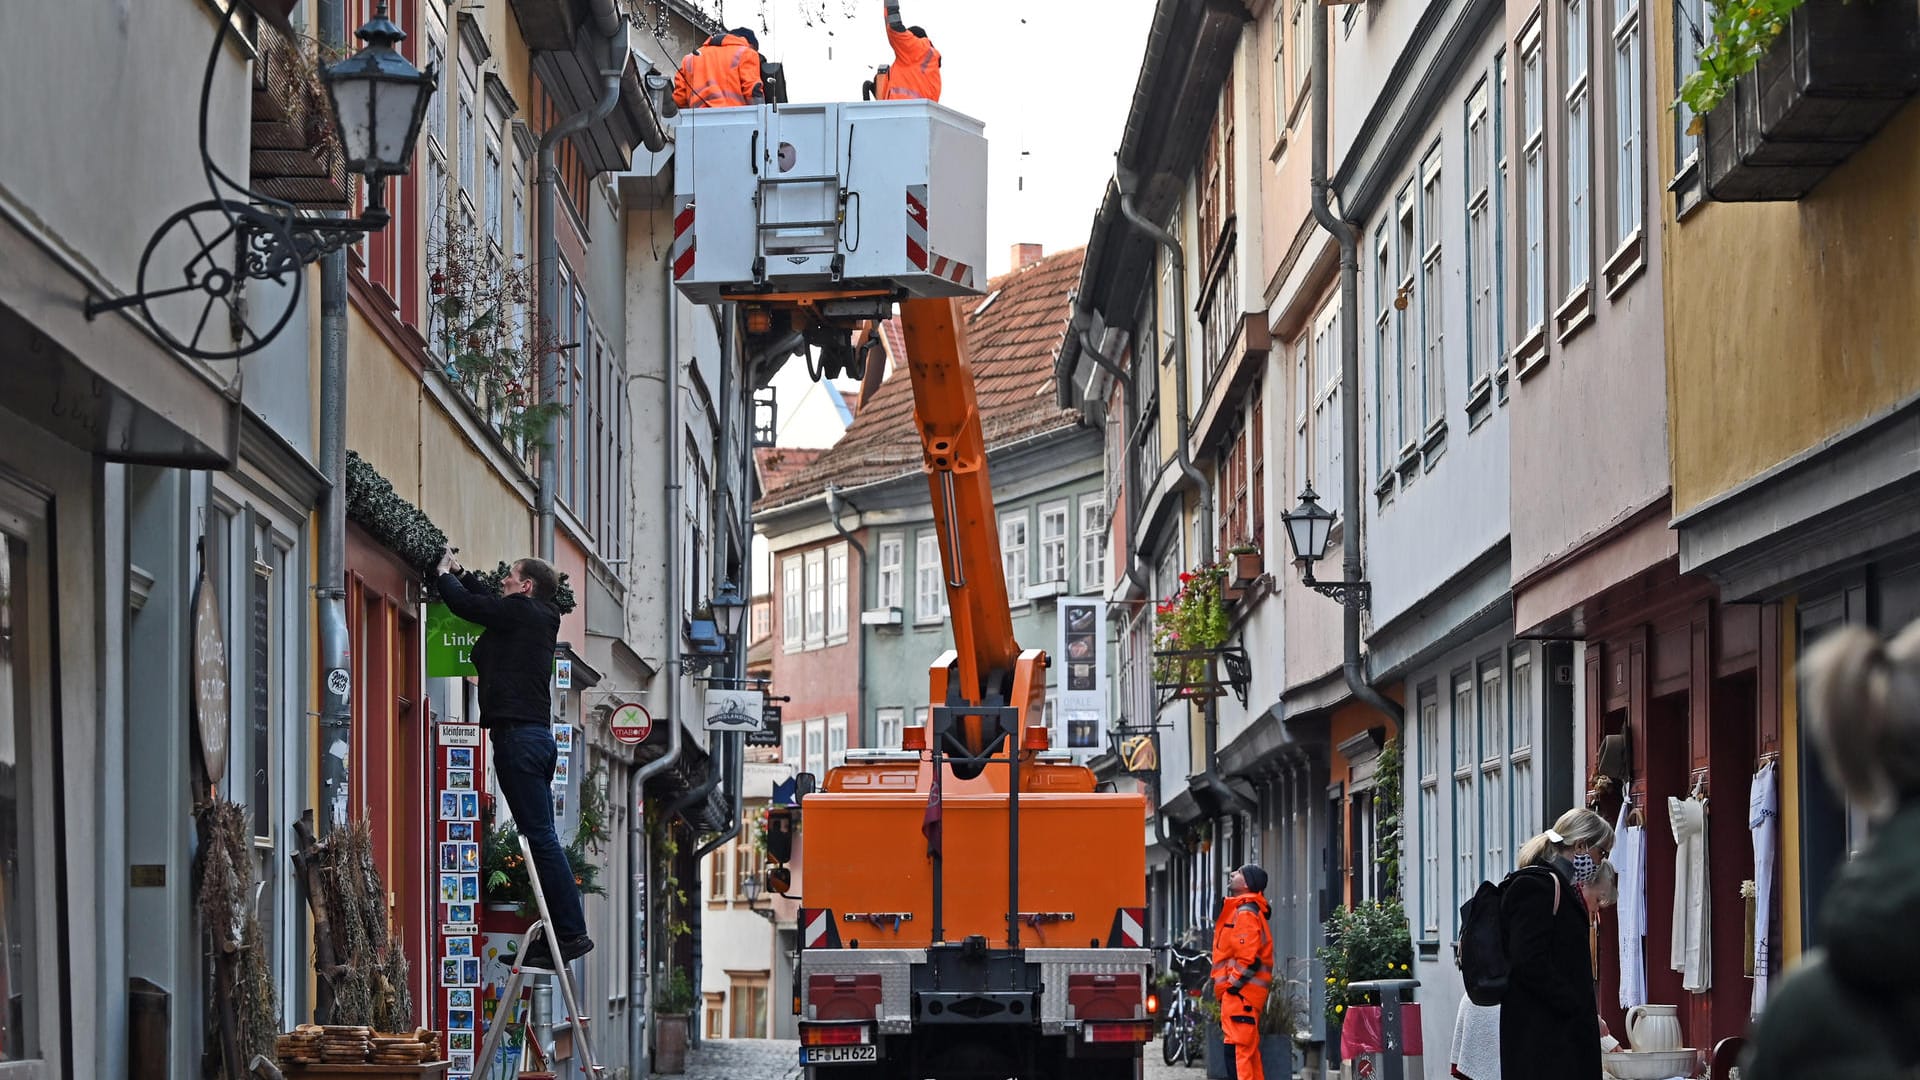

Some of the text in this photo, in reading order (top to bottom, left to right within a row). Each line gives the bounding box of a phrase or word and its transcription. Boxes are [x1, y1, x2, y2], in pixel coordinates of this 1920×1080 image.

[807, 1047, 875, 1061] EF LH 622
